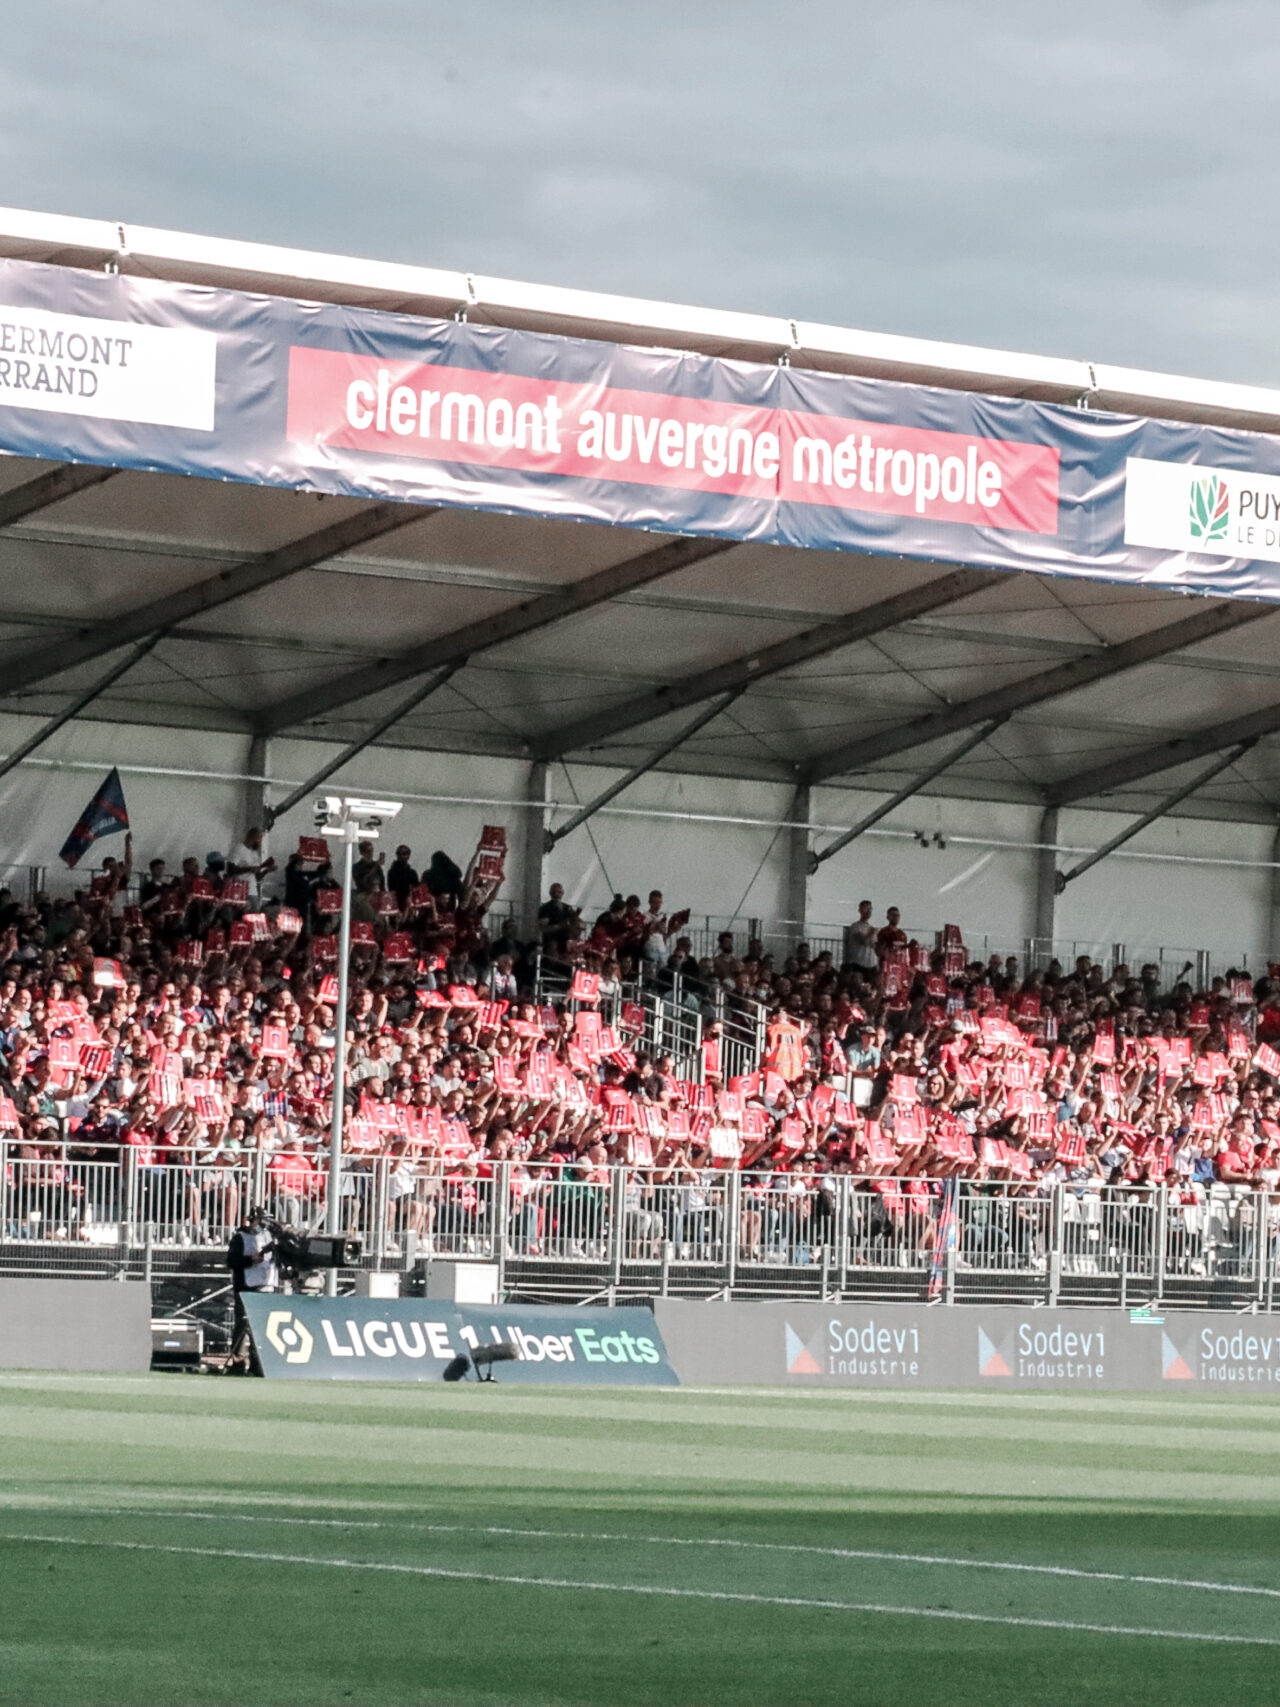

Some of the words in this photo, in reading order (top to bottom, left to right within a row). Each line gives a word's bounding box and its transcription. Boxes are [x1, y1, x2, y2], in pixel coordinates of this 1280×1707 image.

[0, 323, 133, 367] ERMONT
[345, 370, 562, 454] clermont
[577, 408, 780, 480] auvergne
[792, 432, 1002, 513] métropole
[1237, 526, 1254, 544] LE
[320, 1319, 457, 1359] LIGUE
[575, 1327, 660, 1364] Eats
[828, 1319, 920, 1354] Sodevi
[1018, 1323, 1105, 1358] Sodevi
[828, 1355, 920, 1376] Industrie
[1018, 1359, 1105, 1379] Industrie
